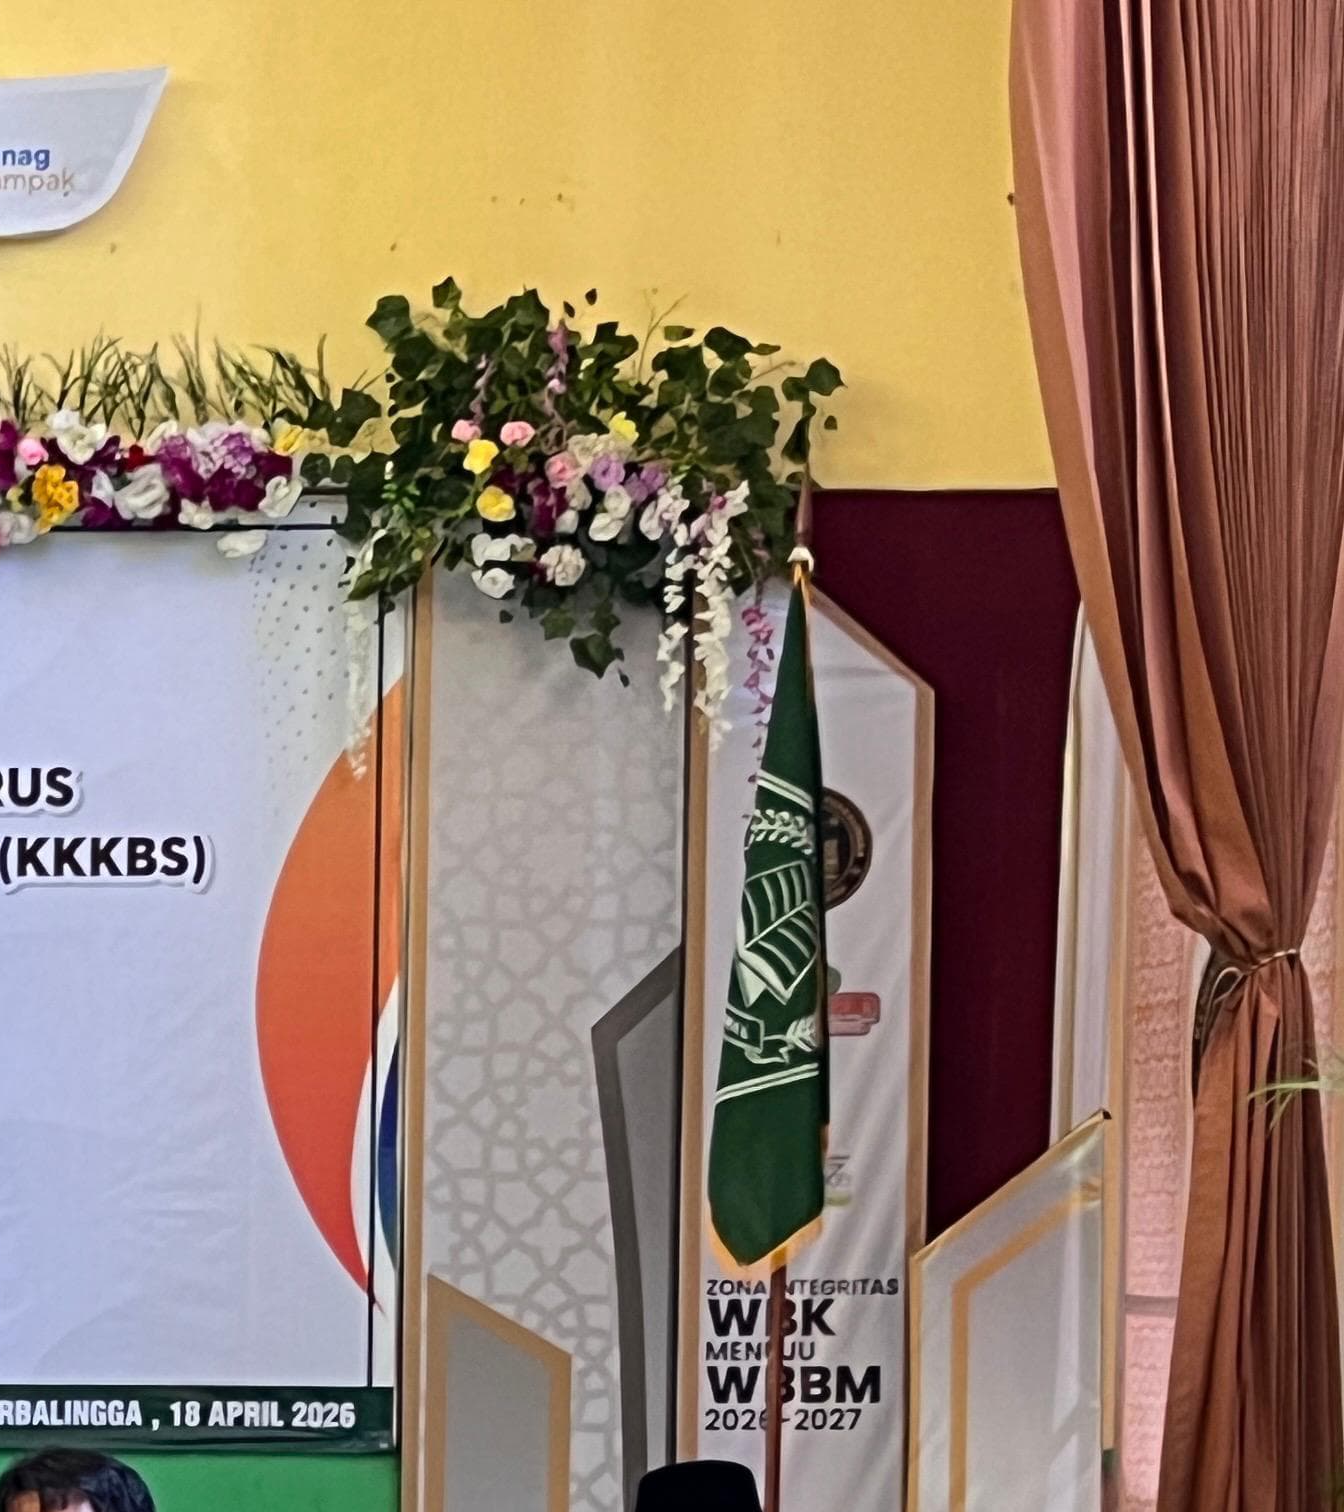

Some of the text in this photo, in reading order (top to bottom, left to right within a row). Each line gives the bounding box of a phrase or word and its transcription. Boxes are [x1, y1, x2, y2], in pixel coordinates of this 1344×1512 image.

[706, 1278, 899, 1296] ZONA NTEGRITAS
[708, 1299, 836, 1336] WBK
[169, 1400, 201, 1427] 18
[207, 1401, 284, 1428] APRIL
[291, 1402, 356, 1428] 2026
